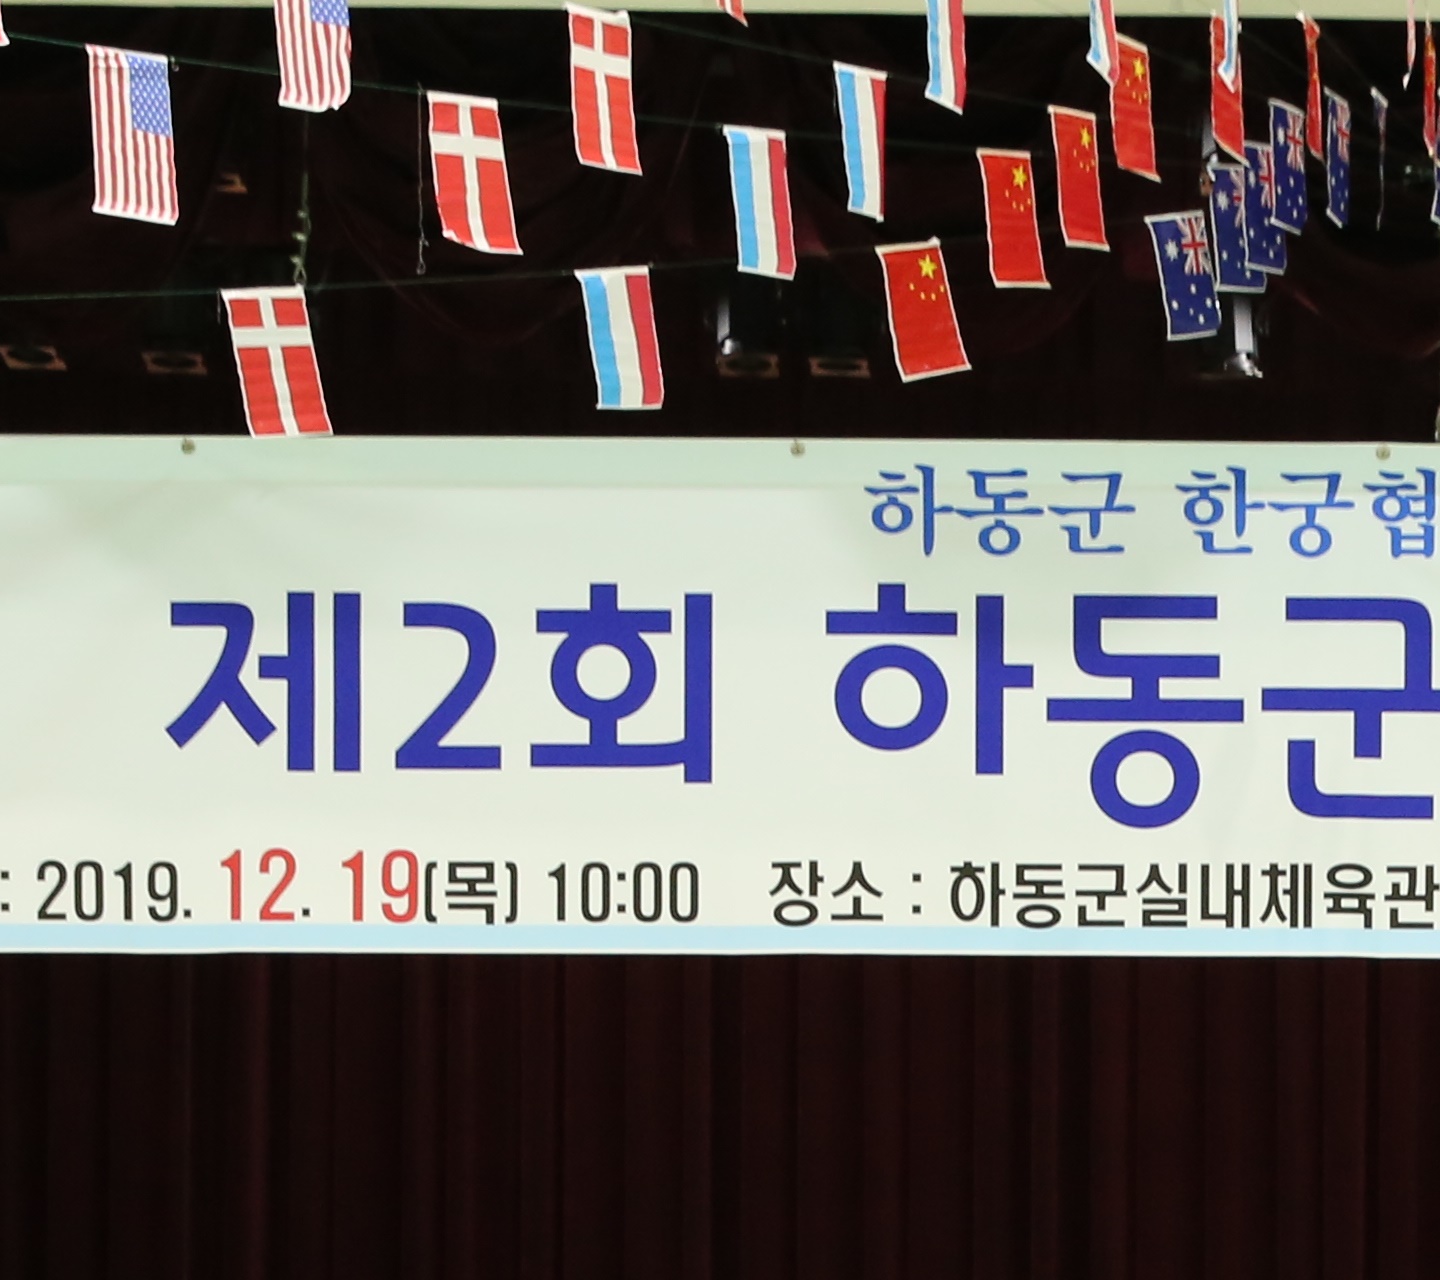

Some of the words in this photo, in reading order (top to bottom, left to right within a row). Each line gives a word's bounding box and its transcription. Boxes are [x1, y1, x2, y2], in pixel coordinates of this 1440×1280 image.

[864, 465, 1135, 556] 하동군
[165, 583, 713, 783] 제2회
[37, 860, 191, 922] 2019.
[221, 848, 310, 921] 12.
[548, 862, 699, 923] 10:00
[769, 860, 883, 927] 장소
[950, 861, 1440, 929] 하동군실내체육관
